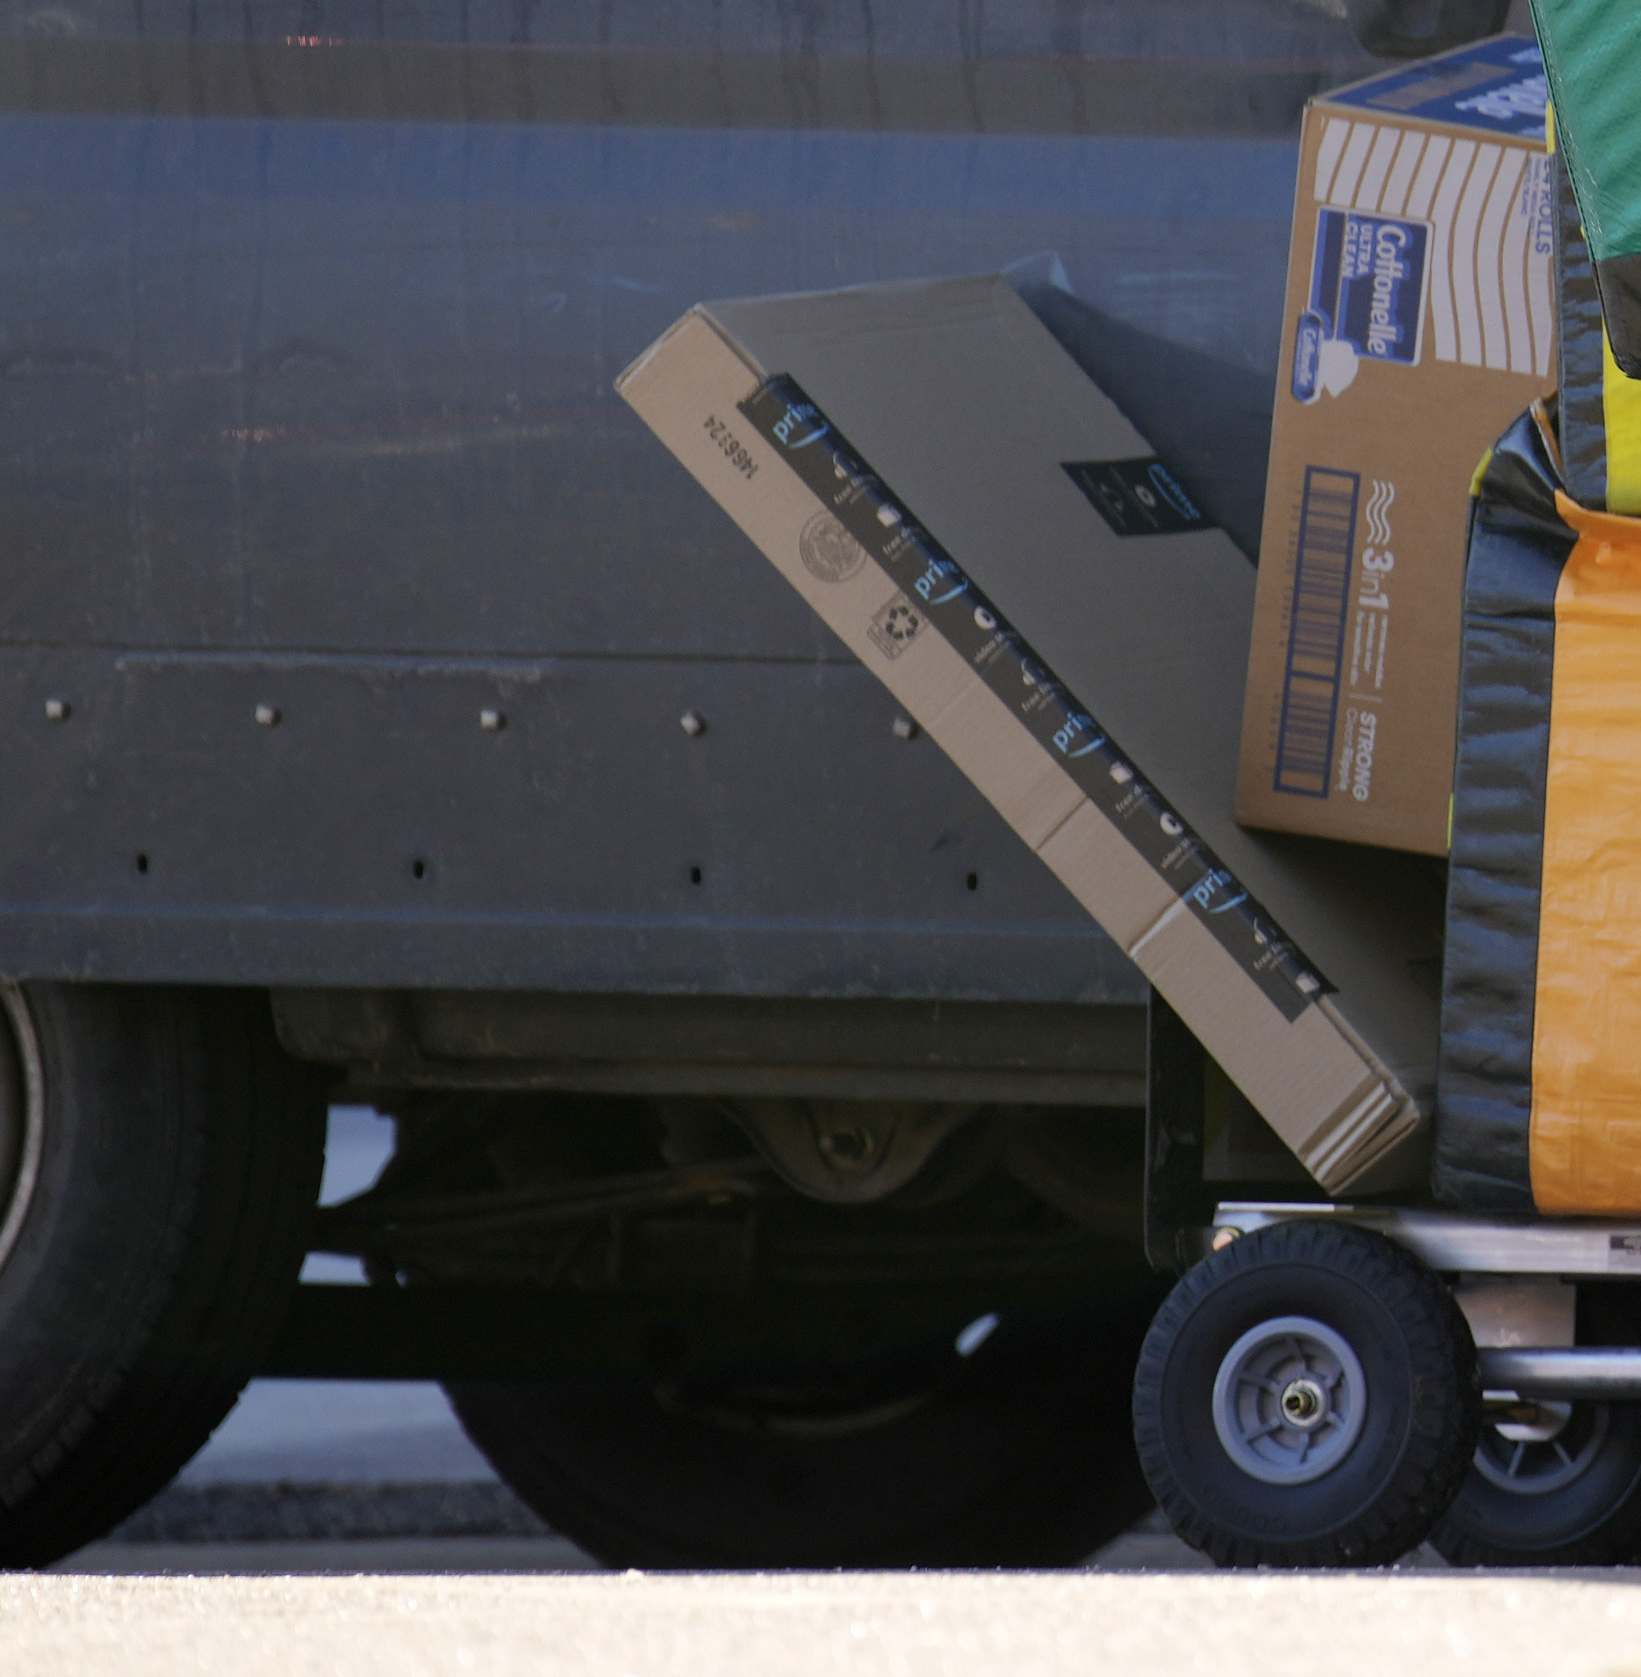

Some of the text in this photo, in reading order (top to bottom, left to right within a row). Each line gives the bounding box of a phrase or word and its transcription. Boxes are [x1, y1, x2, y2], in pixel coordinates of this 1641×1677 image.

[1342, 221, 1359, 278] CLEAN
[1356, 224, 1373, 275] ULTRA
[1367, 224, 1406, 355] Cottonelle
[1358, 548, 1394, 609] 3in1
[1352, 711, 1377, 801] STRONG
